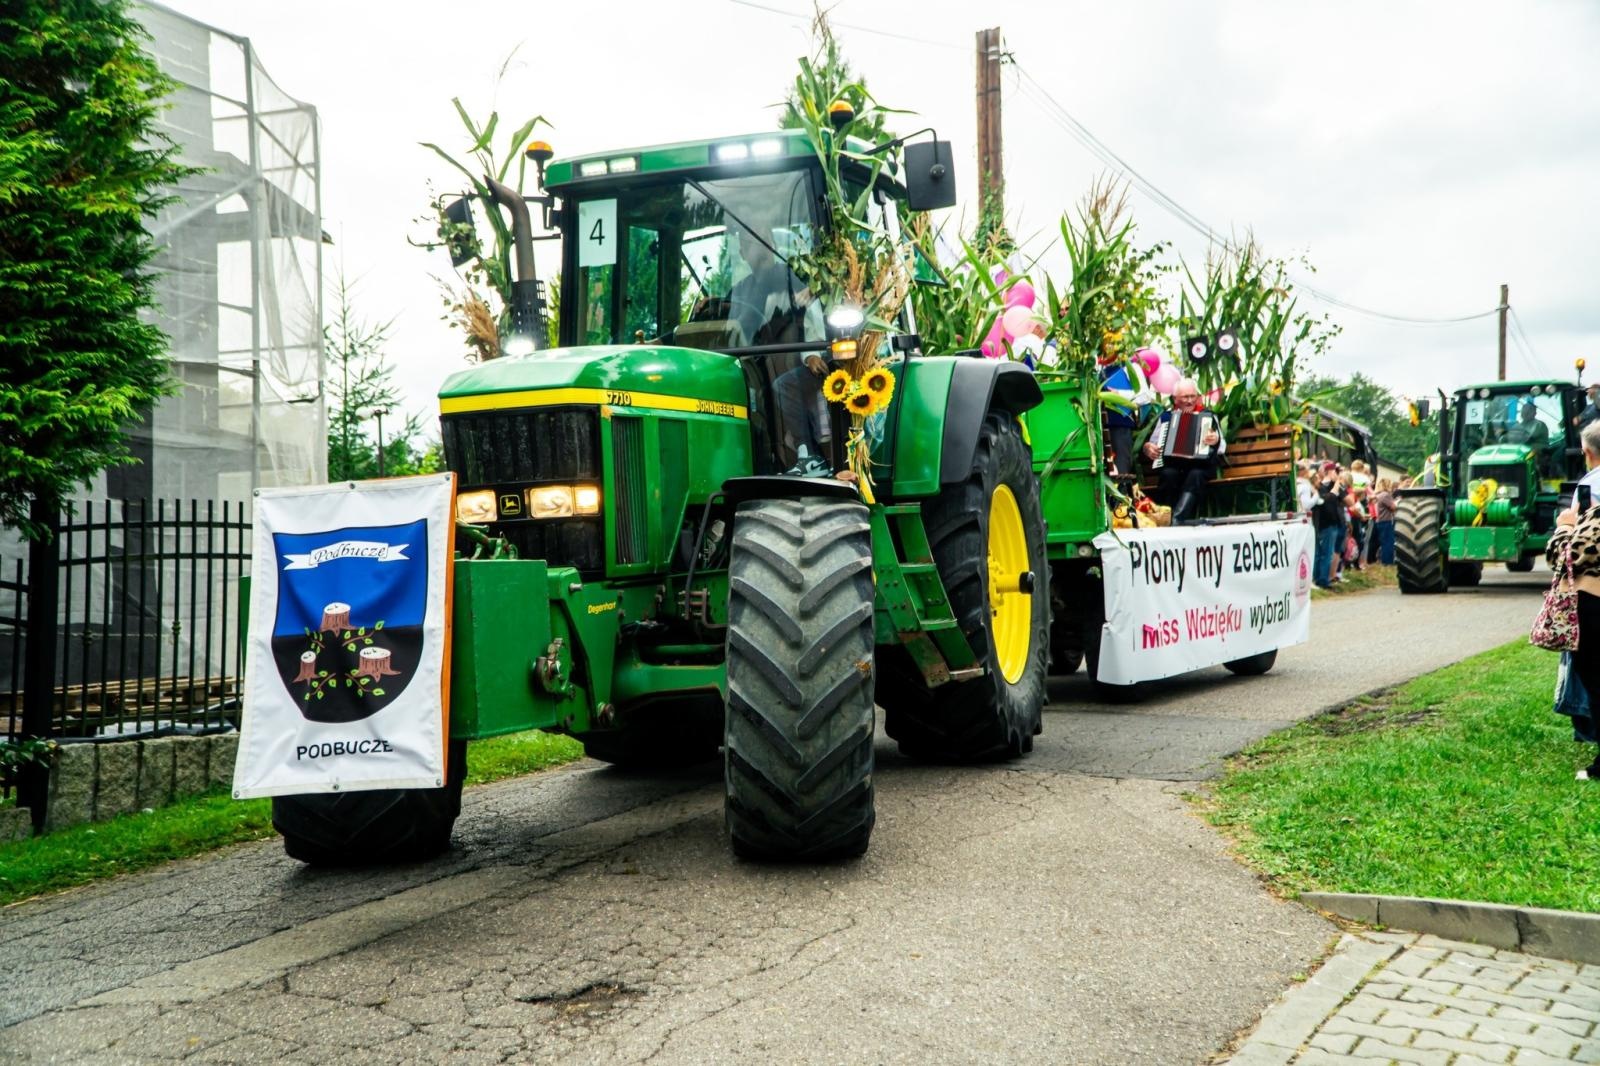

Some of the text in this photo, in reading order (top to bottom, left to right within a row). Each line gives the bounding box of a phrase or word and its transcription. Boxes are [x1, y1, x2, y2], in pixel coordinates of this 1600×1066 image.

[589, 218, 606, 246] 4
[606, 391, 632, 406] 7710
[696, 400, 735, 417] JOHN DEERE
[1471, 408, 1479, 418] 5
[314, 543, 387, 563] Podbucze
[1130, 530, 1290, 593] Plony my zebrali
[1185, 603, 1243, 642] Wdzięku
[1250, 592, 1291, 634] wybrali
[296, 739, 393, 760] PODBUCZE
